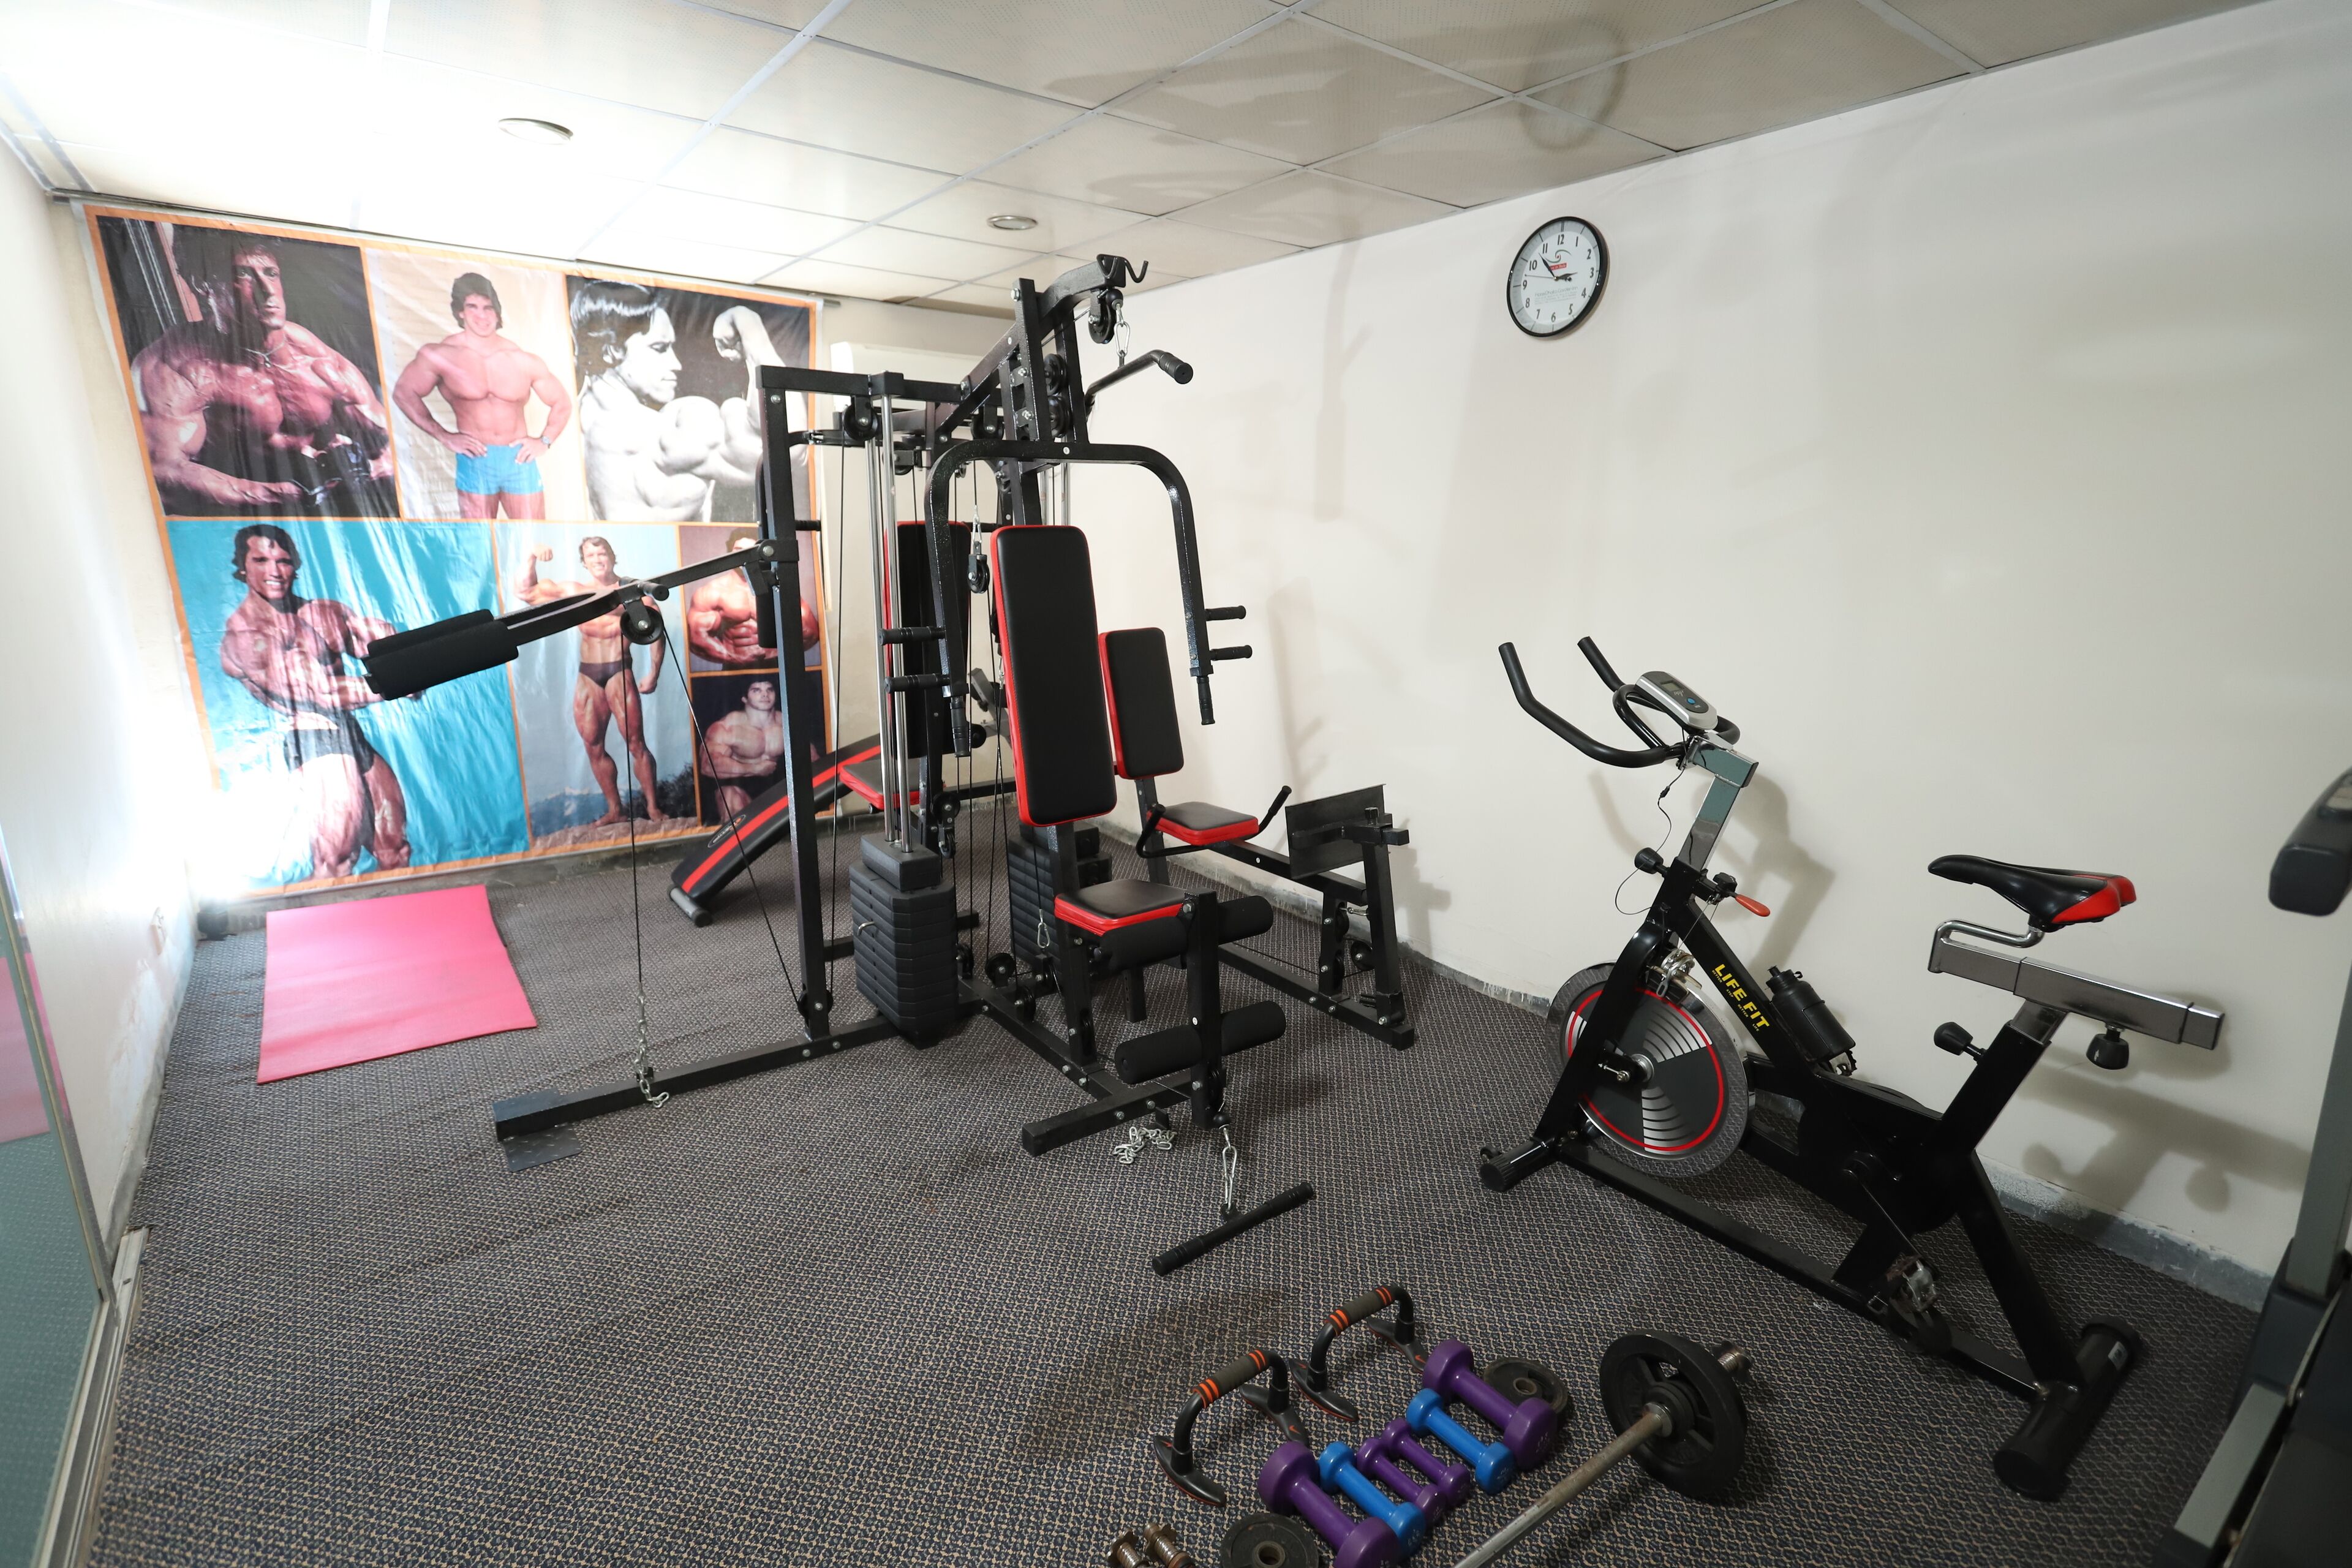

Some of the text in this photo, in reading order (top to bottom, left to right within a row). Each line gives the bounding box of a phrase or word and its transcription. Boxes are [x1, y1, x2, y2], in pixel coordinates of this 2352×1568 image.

[1558, 234, 1564, 246] 12
[1575, 236, 1579, 247] 1
[1542, 243, 1548, 254] 11
[1586, 249, 1592, 260] 2
[1529, 260, 1537, 271] 10
[1589, 267, 1594, 278] 3
[1523, 279, 1527, 290] 9
[1581, 287, 1586, 298] 4
[1525, 298, 1530, 308] 8
[1536, 309, 1540, 319] 7
[1568, 303, 1573, 315] 5
[1551, 312, 1556, 322] 6
[1715, 963, 1770, 1027] LIFE FIT
